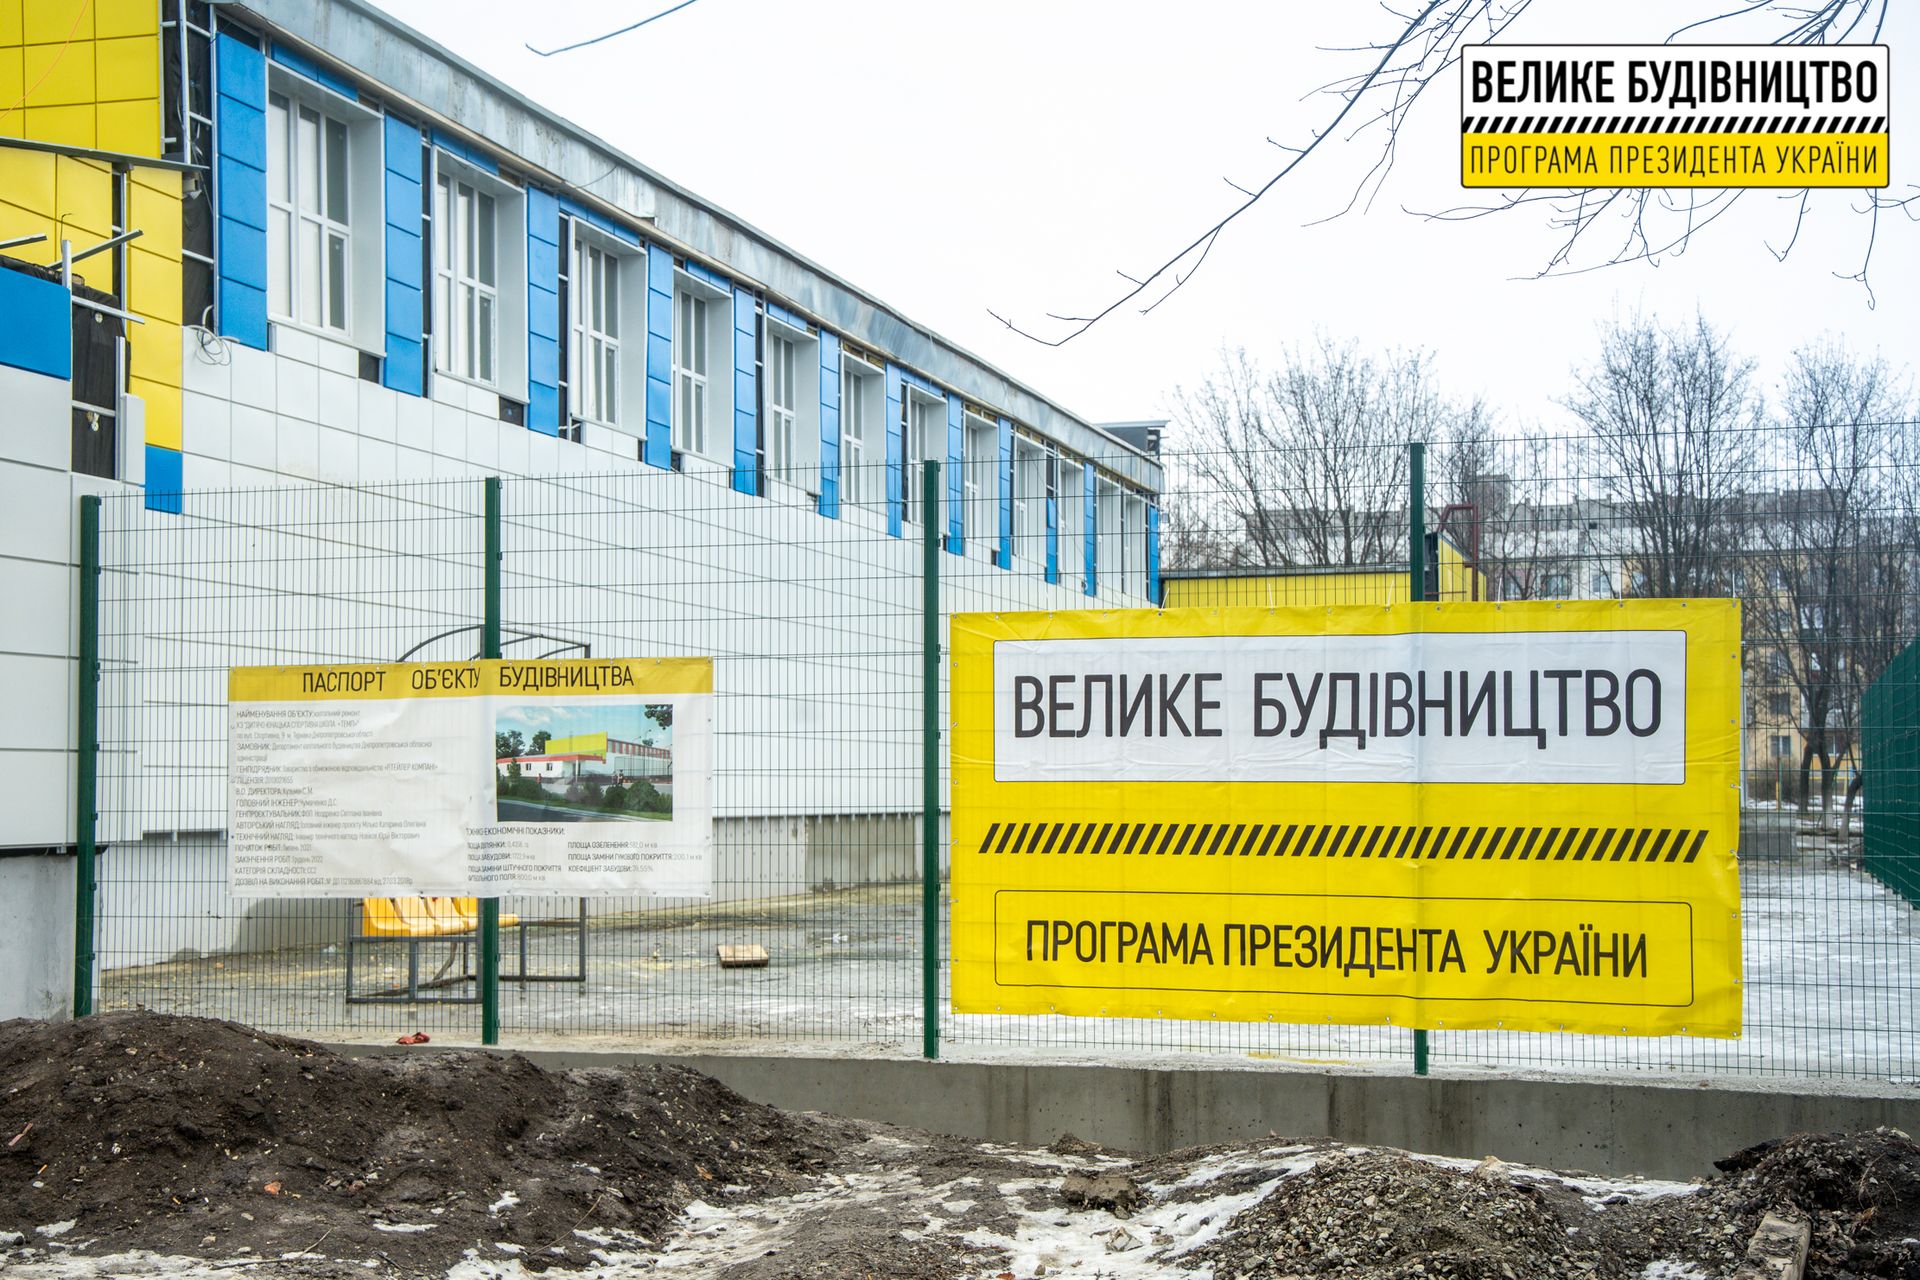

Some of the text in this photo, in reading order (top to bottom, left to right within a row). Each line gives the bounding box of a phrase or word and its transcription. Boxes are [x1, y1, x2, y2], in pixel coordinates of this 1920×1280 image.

[302, 665, 635, 693] ПАСПОРТ ОБ'ЄКТУ БУДІВНИЦТВА
[1014, 668, 1662, 750] ВЕЛИКЕ БУДІВНИЦТВО
[567, 841, 592, 851] ПЛОЩА
[567, 853, 592, 862] ПЛОЩА
[592, 852, 615, 862] ЗАМІНИ
[234, 866, 267, 875] КАТЕГОРІЯ
[502, 863, 534, 872] ШТУЧНОГО
[533, 864, 562, 872] ПОКРИТТЯ
[259, 877, 268, 886] НА
[268, 877, 306, 886] ВИКОНАННЯ
[1026, 919, 1648, 979] ПРОГРАМА ПРЕЗИДЕНТА УКРАЇНИ
